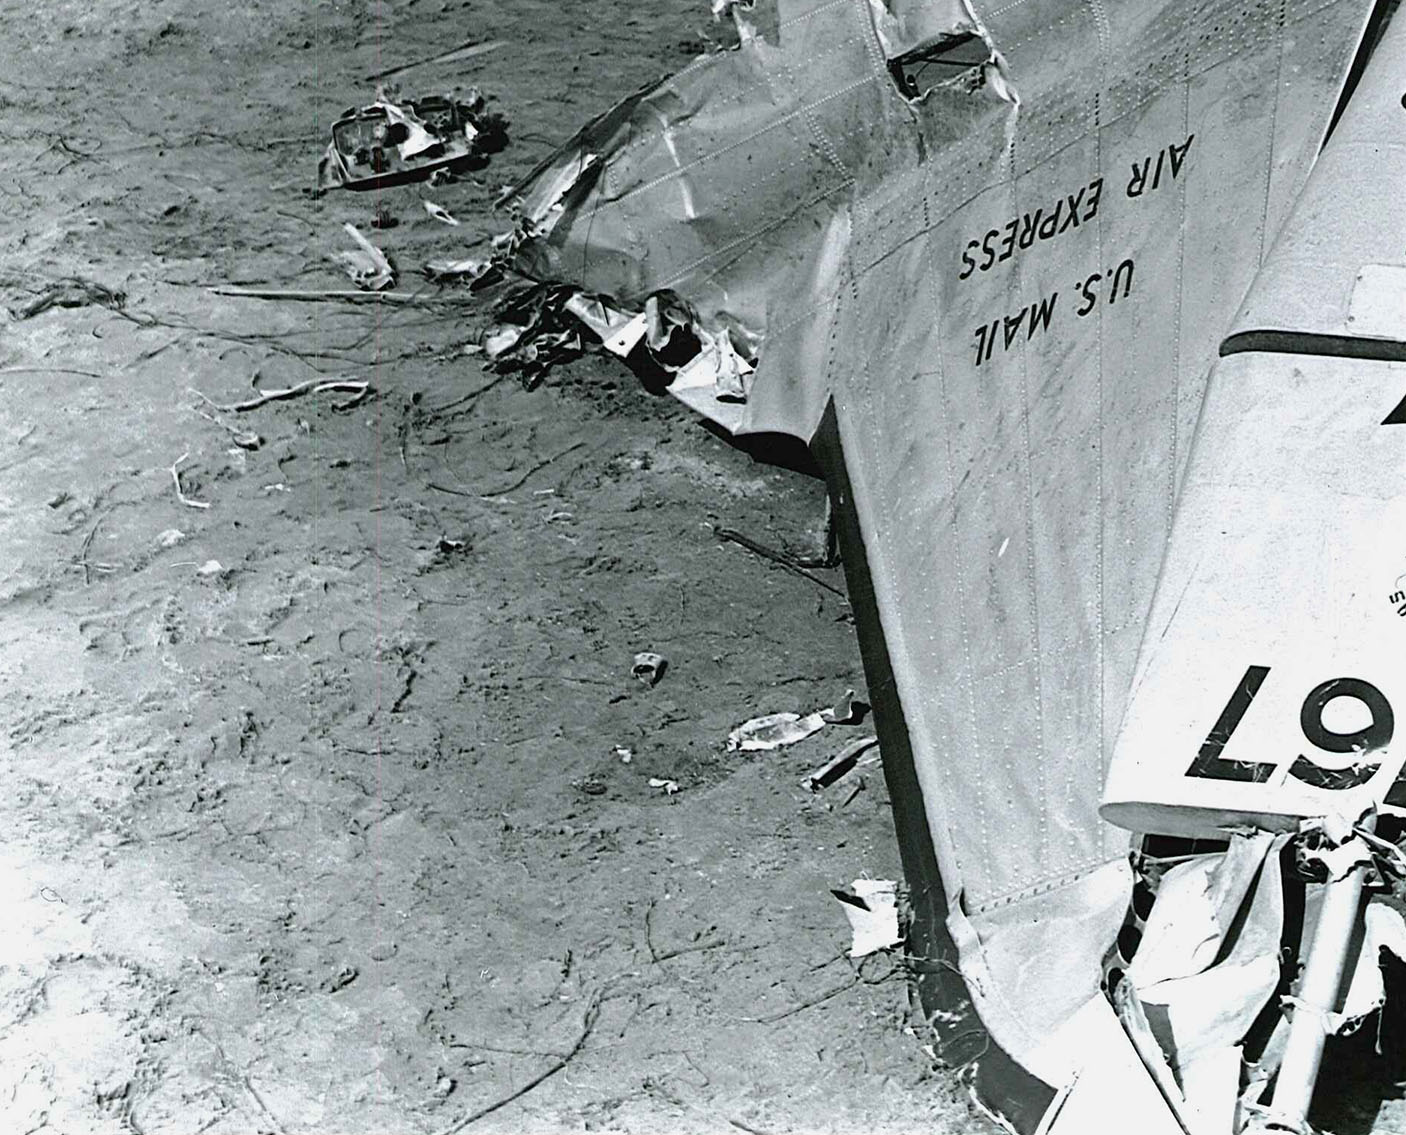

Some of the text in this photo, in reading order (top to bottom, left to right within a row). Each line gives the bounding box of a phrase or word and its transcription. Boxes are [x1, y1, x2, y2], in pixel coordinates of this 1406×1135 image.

[959, 133, 1196, 281] AIR EXPRESS
[973, 258, 1135, 367] U.S. MAIL
